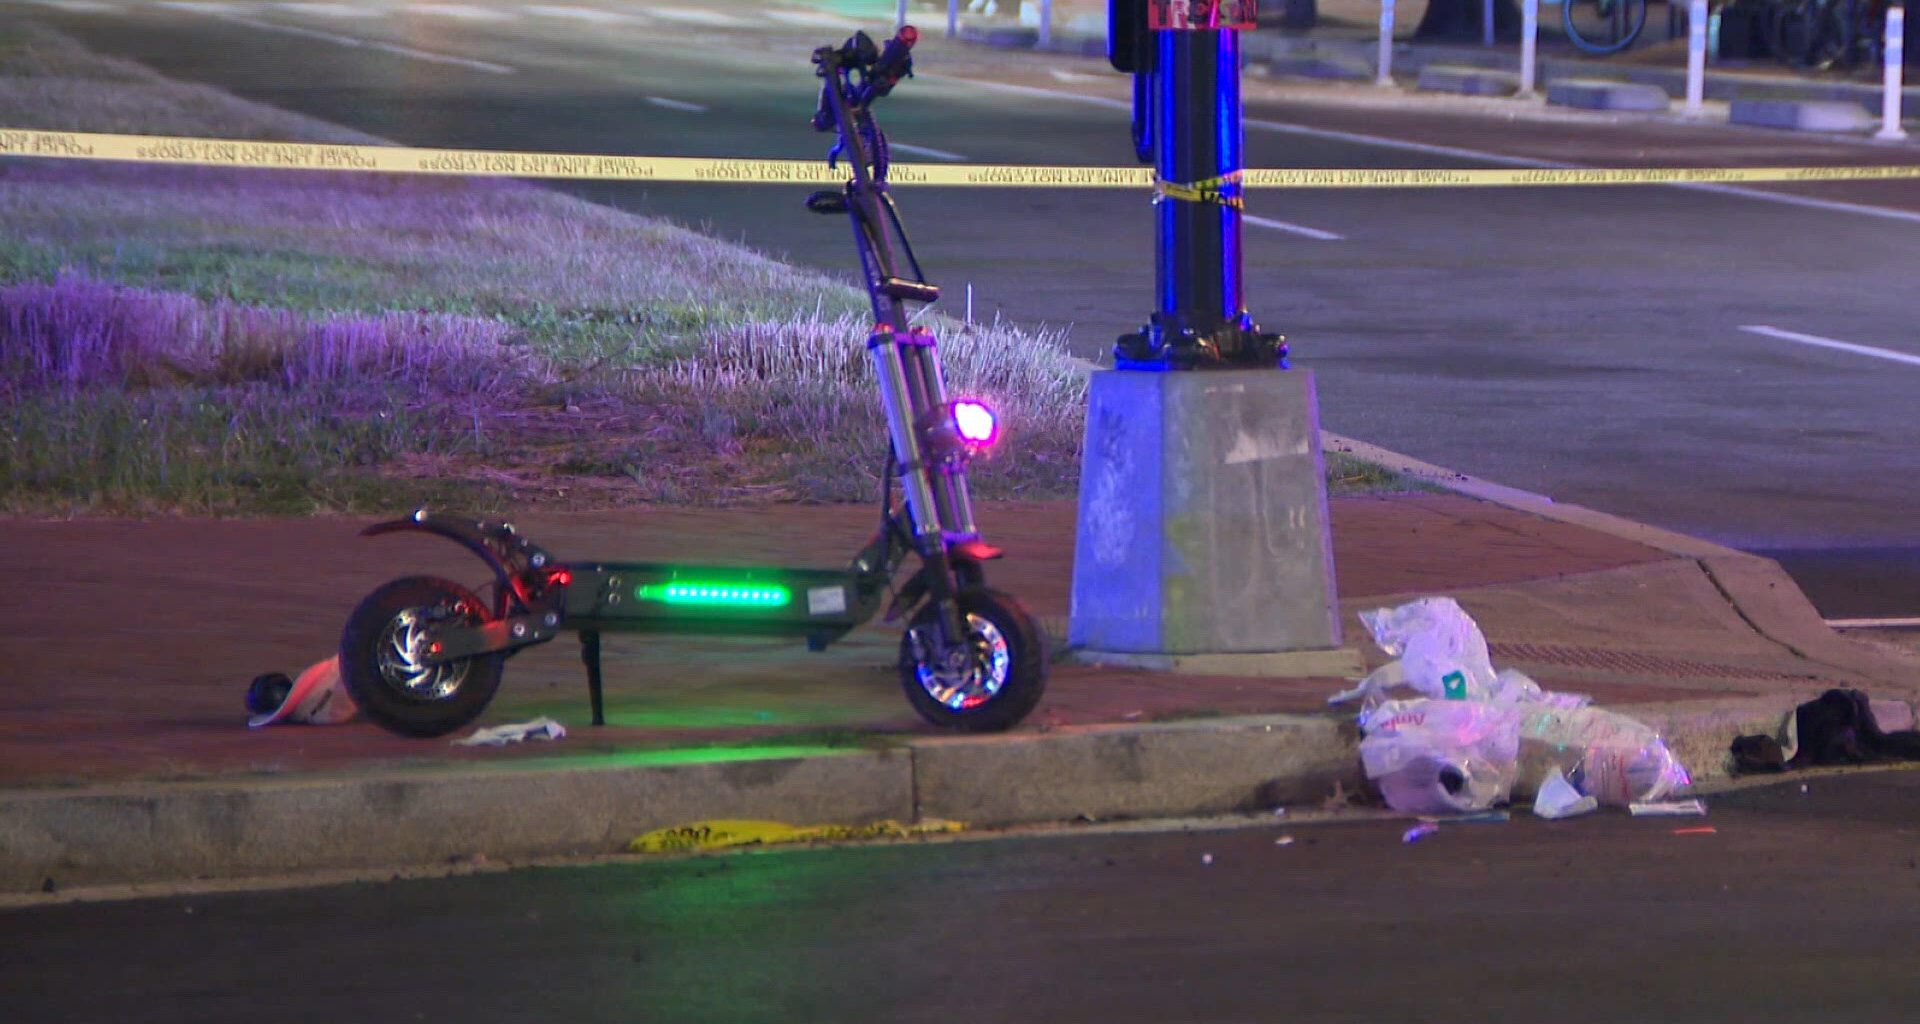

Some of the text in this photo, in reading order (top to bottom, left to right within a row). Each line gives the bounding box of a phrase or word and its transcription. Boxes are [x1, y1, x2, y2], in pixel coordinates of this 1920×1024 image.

[417, 159, 476, 171] CROSS
[484, 161, 516, 172] NOT
[549, 164, 588, 175] LINE
[592, 165, 654, 177] POLICE
[694, 168, 752, 179] CROSS
[759, 169, 791, 180] NOT
[796, 170, 820, 181] DO
